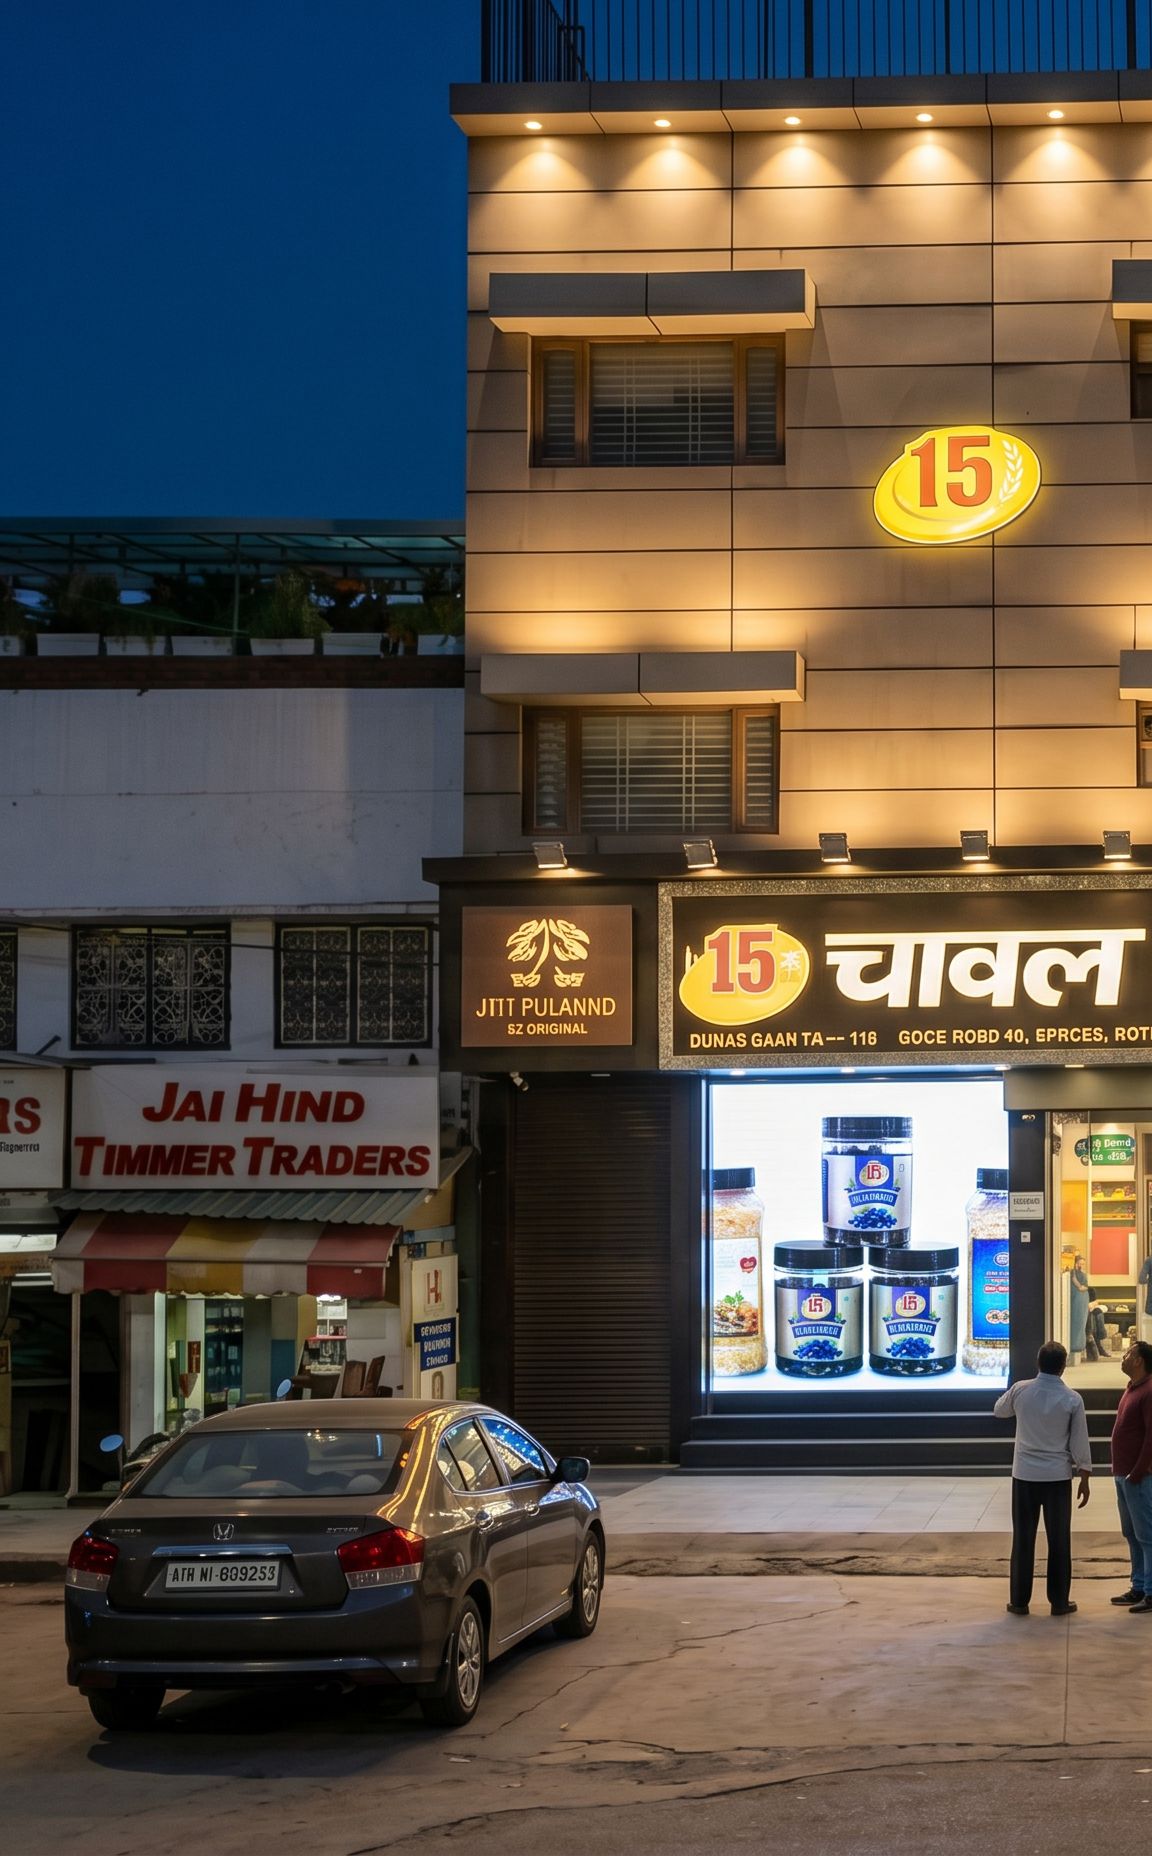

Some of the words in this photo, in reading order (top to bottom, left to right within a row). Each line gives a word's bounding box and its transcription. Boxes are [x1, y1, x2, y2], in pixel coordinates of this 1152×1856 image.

[911, 435, 993, 507] 15
[708, 931, 775, 994] 15
[825, 930, 1146, 1008] चावल
[522, 997, 616, 1017] PULANND
[507, 1023, 523, 1035] SZ
[527, 1023, 588, 1035] ORIGINAL
[689, 1033, 747, 1049] DUNAS
[751, 1032, 797, 1048] GAAN
[898, 1029, 947, 1045] GOCE
[952, 1029, 1000, 1044] ROBD
[1003, 1029, 1029, 1045] 40,
[142, 1082, 226, 1122] JAI
[235, 1083, 365, 1123] HIND
[74, 1137, 236, 1176] TIMMER
[243, 1137, 431, 1177] TRADERS
